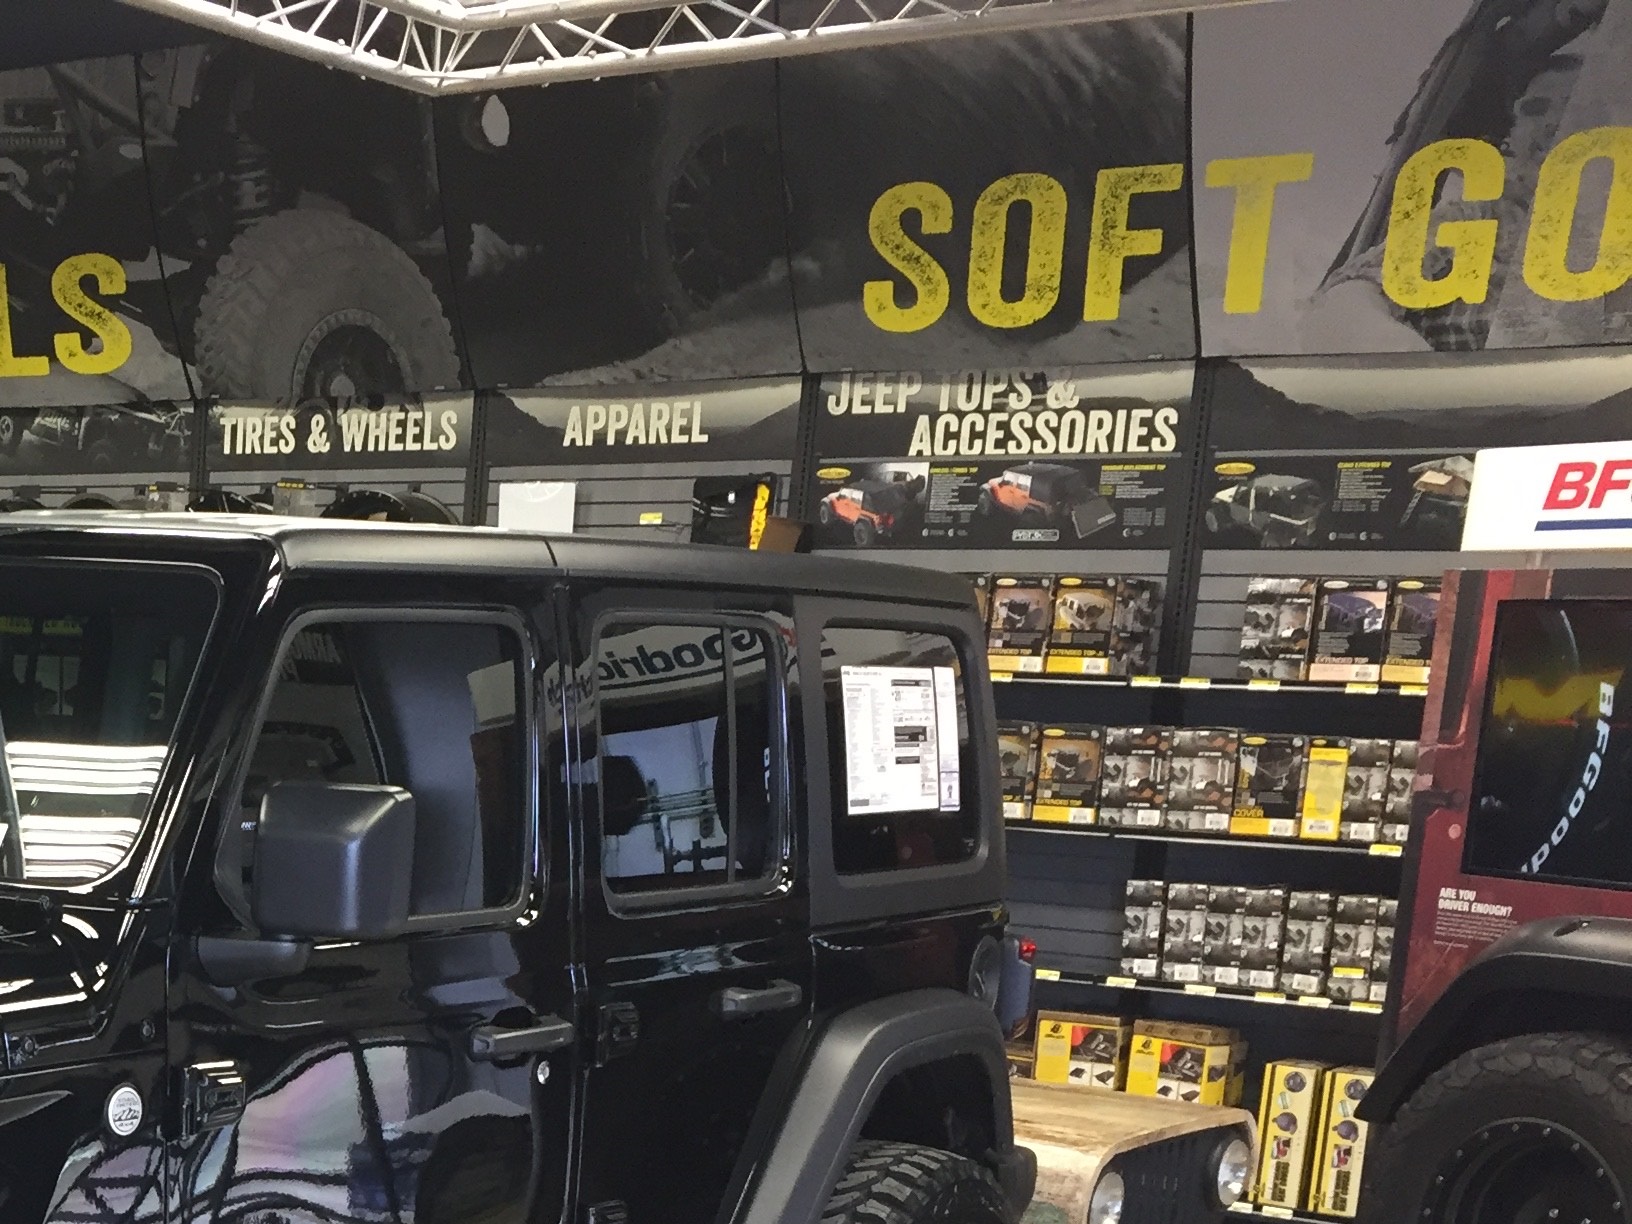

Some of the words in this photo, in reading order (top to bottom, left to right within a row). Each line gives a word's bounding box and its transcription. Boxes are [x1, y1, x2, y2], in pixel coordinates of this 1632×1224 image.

[863, 153, 1314, 333] SOFT
[1380, 126, 1632, 310] GO
[827, 368, 922, 415] JEEP
[938, 370, 1034, 412] TOPS
[1046, 370, 1080, 409] &
[220, 416, 296, 456] TIRES
[307, 413, 330, 454] &
[341, 410, 457, 452] WHEELS
[563, 401, 709, 447] APPAREL
[908, 407, 1179, 456] ACCESSORIES
[1438, 899, 1470, 913] DRIVER
[1471, 902, 1513, 917] ENOUGH?
[1439, 887, 1458, 900] ARE
[1459, 889, 1477, 902] YOU
